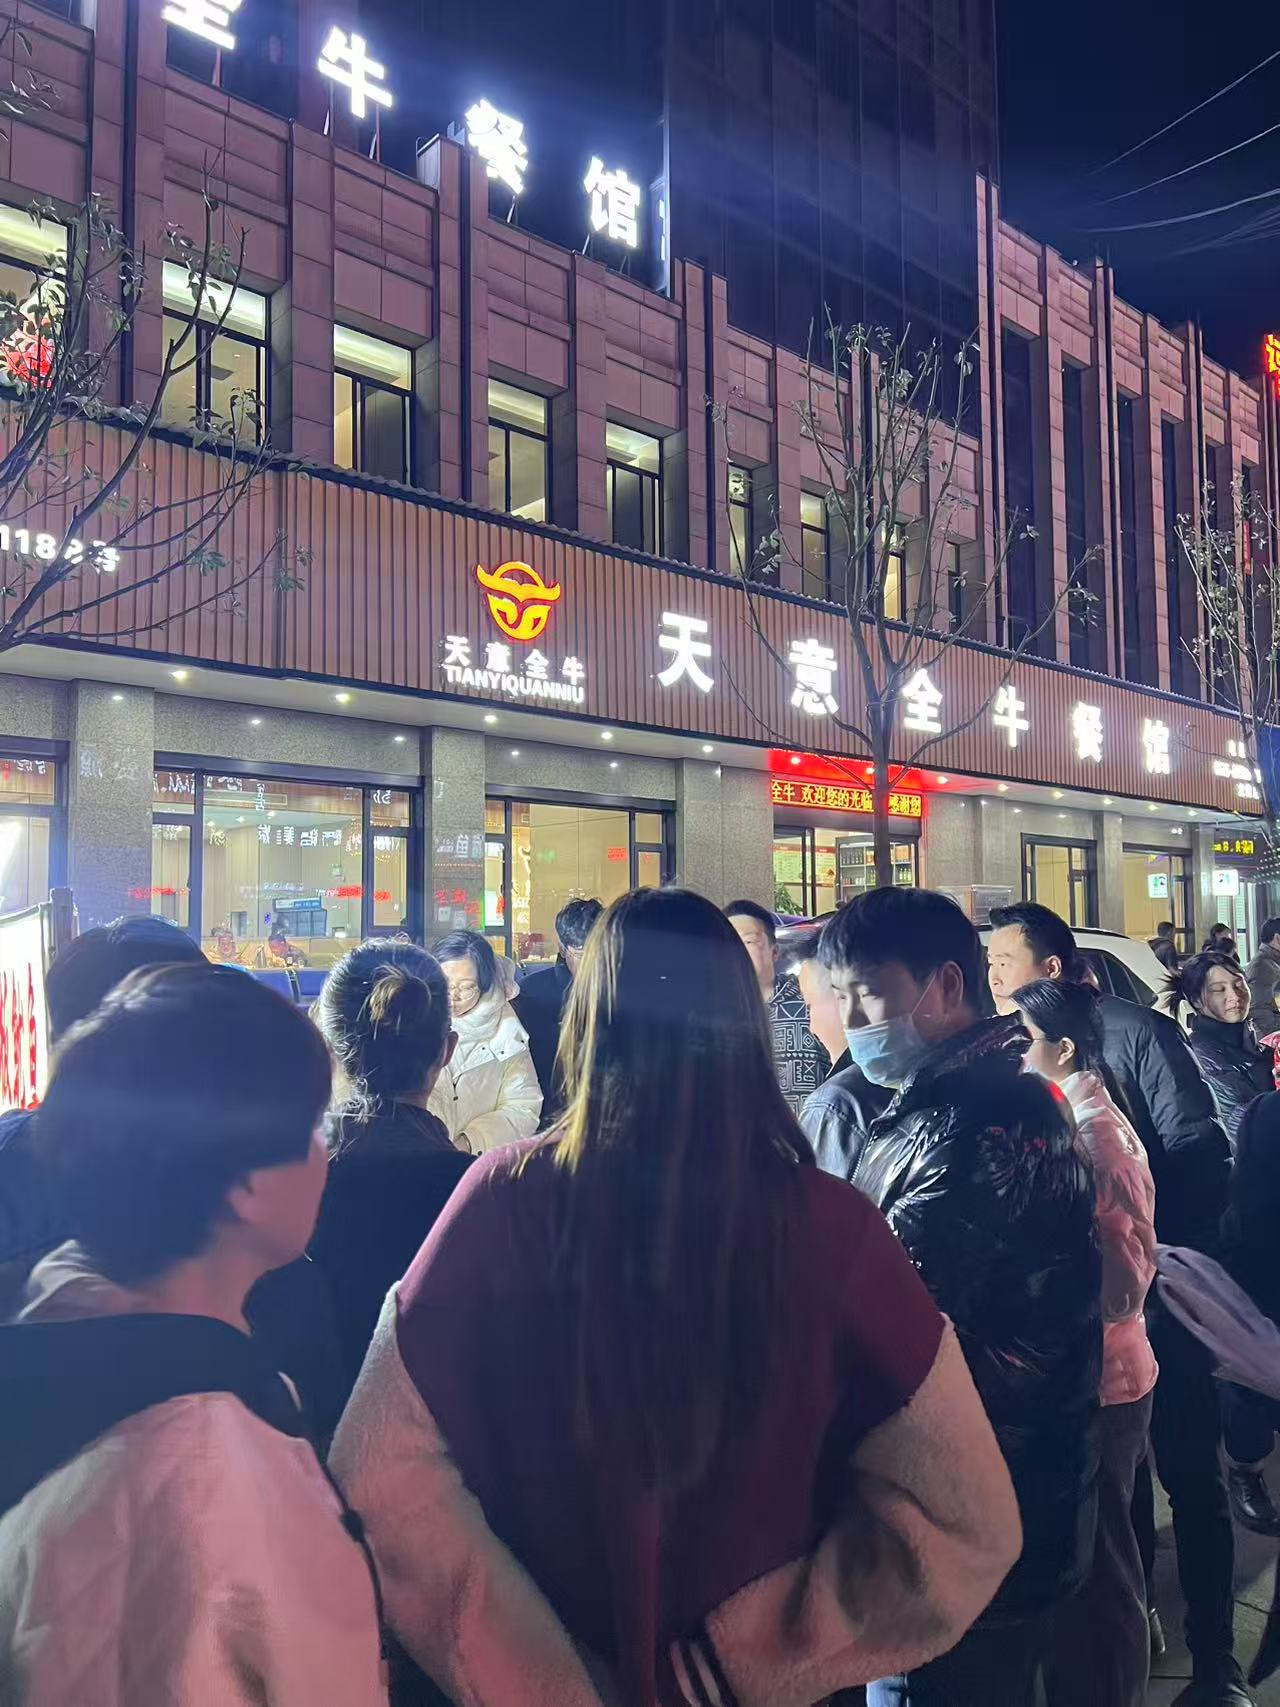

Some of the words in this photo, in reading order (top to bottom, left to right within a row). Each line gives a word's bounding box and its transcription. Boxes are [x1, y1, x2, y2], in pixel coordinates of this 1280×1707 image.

[442, 664, 585, 704] TIANYIQUANNIU
[443, 635, 585, 685] 天意全牛
[657, 611, 1171, 775] 天意全牛餐馆
